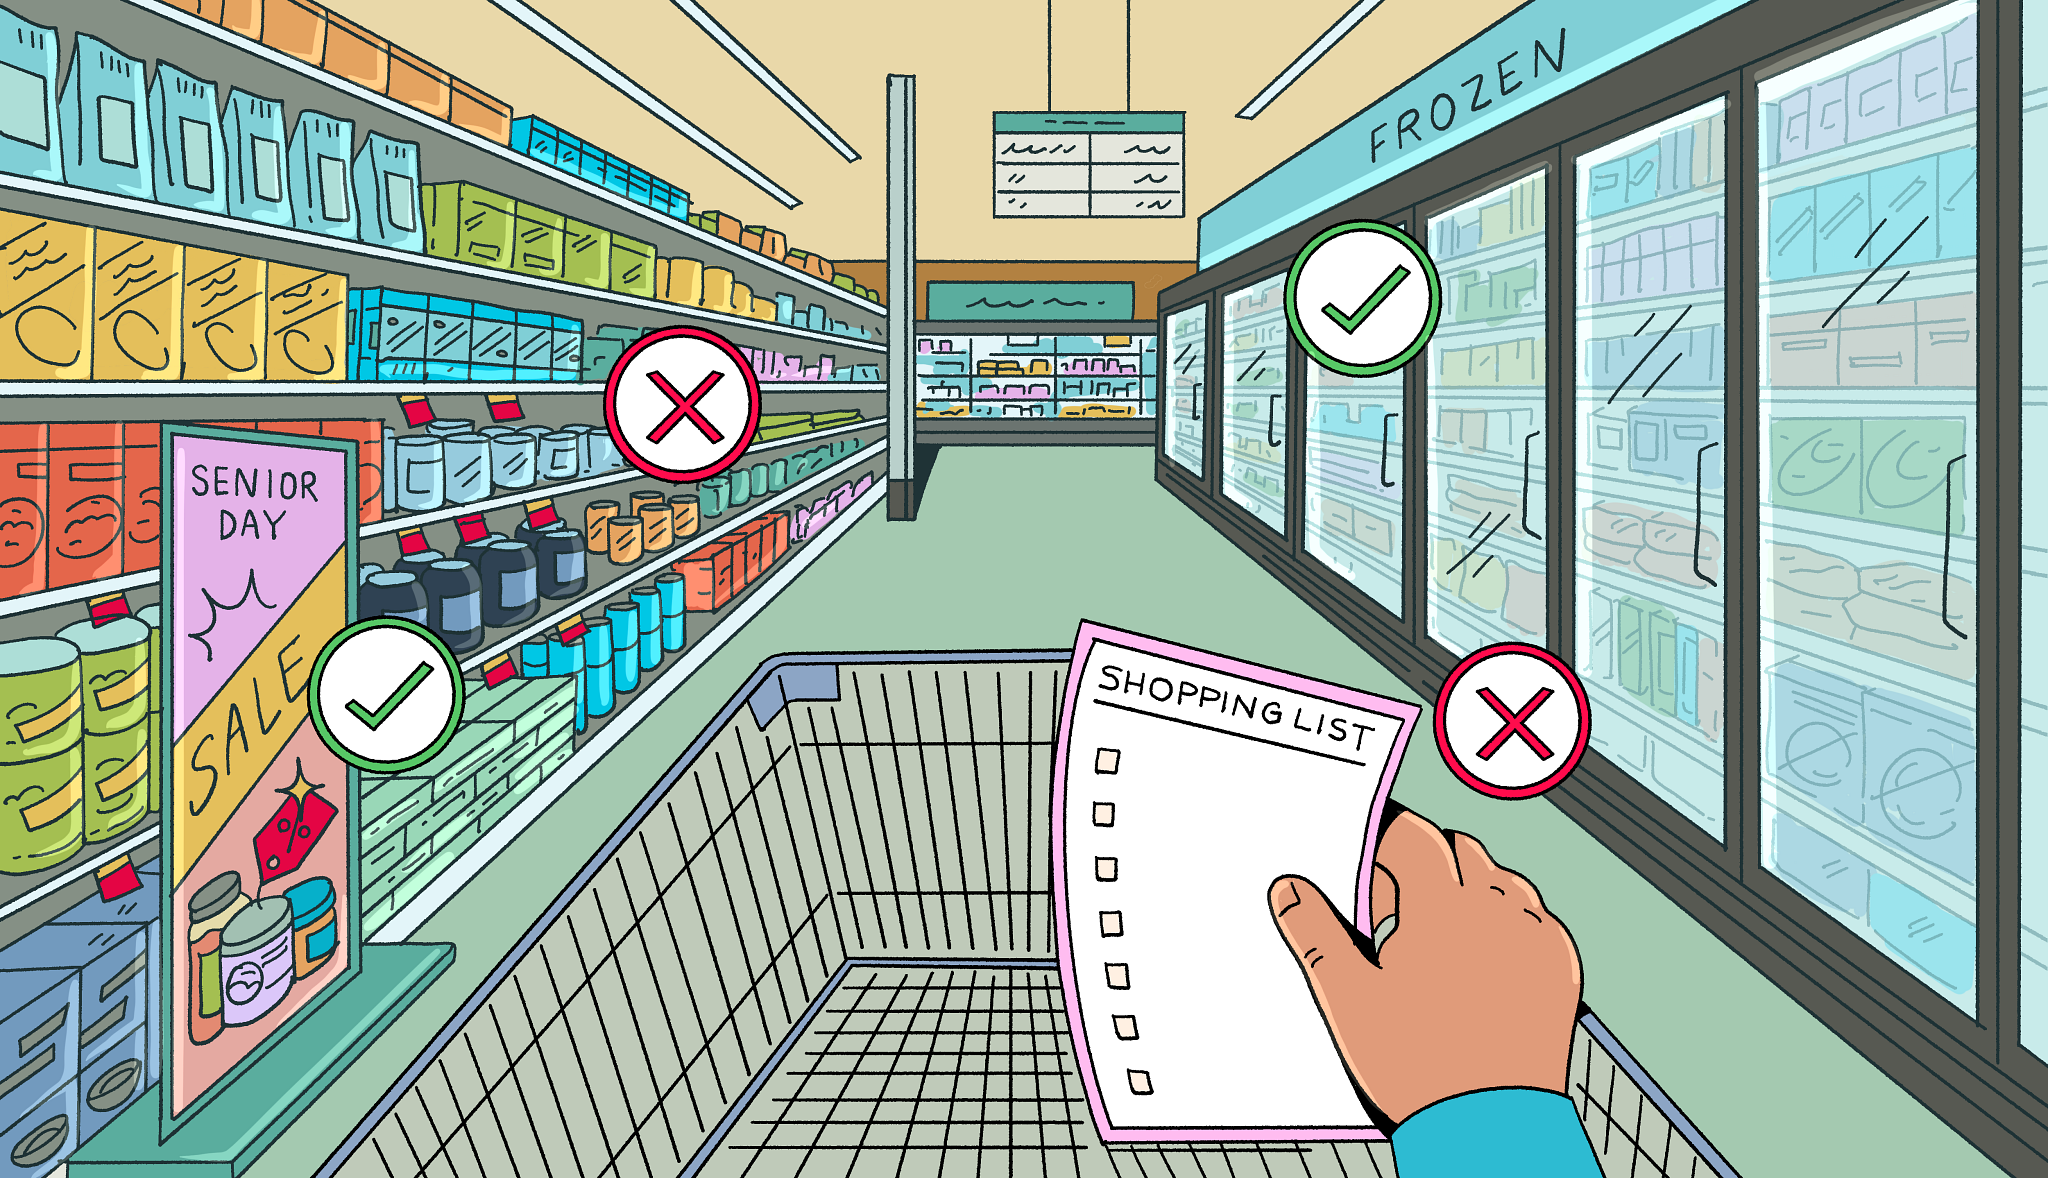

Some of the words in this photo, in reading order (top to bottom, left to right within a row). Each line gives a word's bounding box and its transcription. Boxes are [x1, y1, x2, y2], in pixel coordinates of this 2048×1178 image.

[1370, 27, 1566, 164] FROZEN
[191, 464, 319, 503] SENIOR
[219, 508, 287, 541] DAY
[188, 633, 309, 817] SALE
[1098, 665, 1283, 725] SHOPPING
[1293, 707, 1376, 752] LIST
